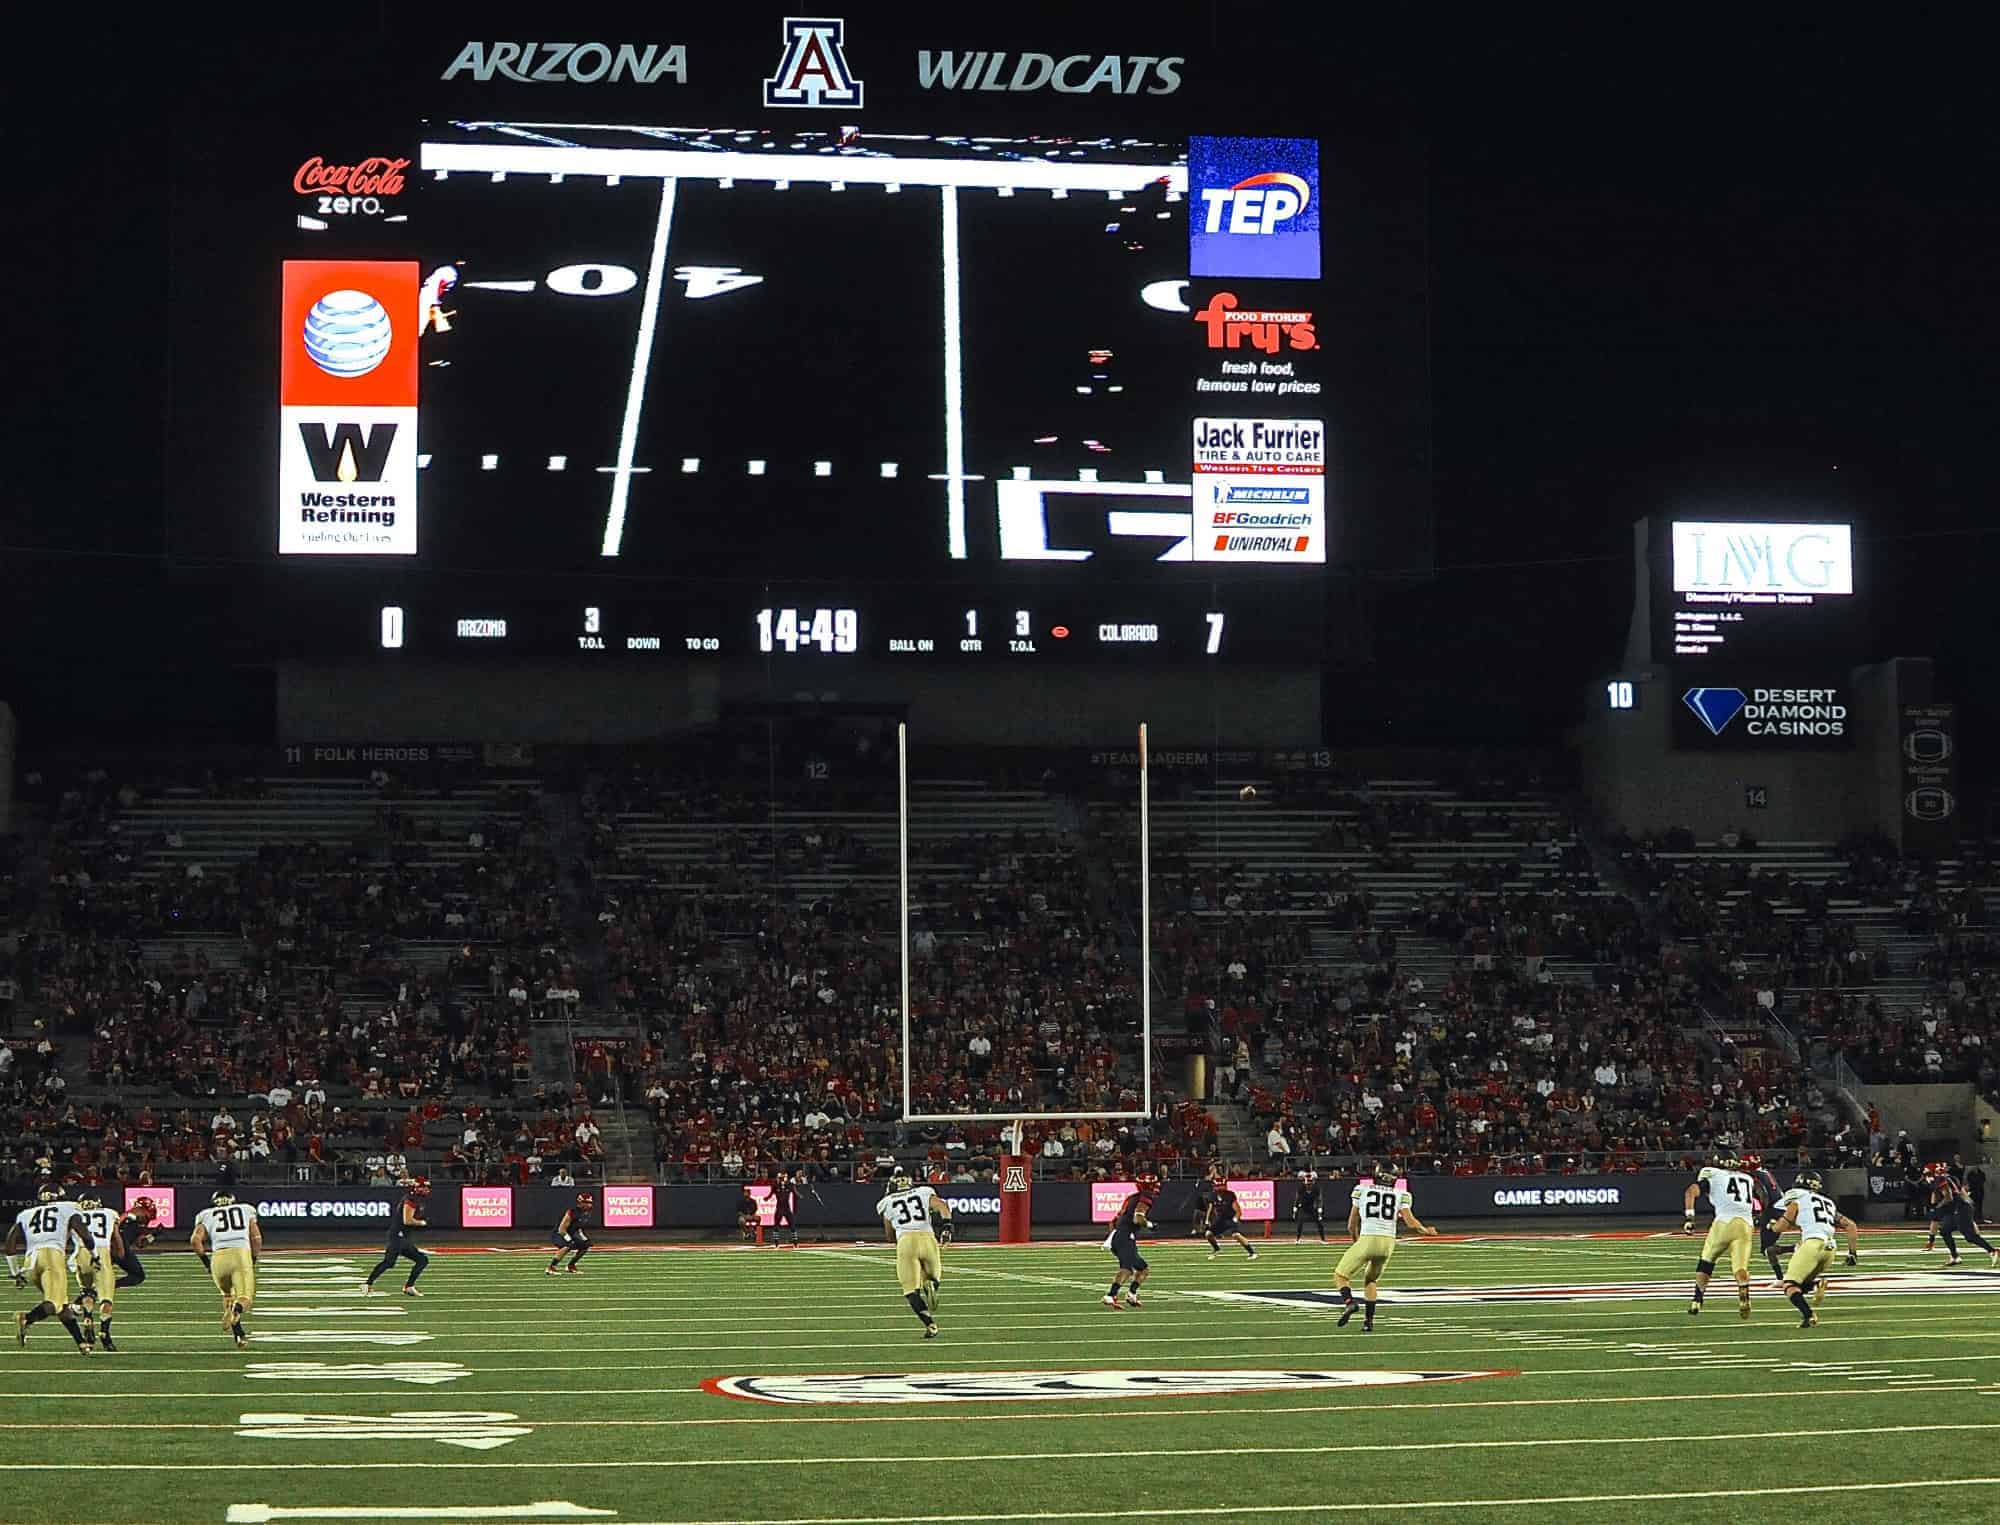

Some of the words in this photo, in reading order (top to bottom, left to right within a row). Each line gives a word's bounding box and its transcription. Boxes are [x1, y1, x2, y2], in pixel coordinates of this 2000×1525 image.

[441, 41, 688, 84] ARIZONA
[763, 17, 864, 108] A
[918, 50, 1185, 95] WILDCATS
[1201, 188, 1299, 235] TEP
[1224, 312, 1257, 322] FOOD
[1260, 312, 1306, 322] STORES
[1221, 361, 1256, 374] fresh
[1260, 362, 1295, 376] food,
[1197, 379, 1248, 393] famous
[1251, 380, 1276, 393] low
[1278, 381, 1321, 395] prices
[1197, 422, 1245, 450] Jack
[1253, 423, 1320, 450] Furrier
[298, 422, 398, 483] W
[1199, 450, 1229, 461] TIRE
[1232, 451, 1240, 461] &
[1246, 451, 1282, 462] AUTO
[1286, 452, 1321, 462] CARE
[1200, 464, 1249, 473] Western
[1252, 465, 1274, 473] Tire
[1277, 465, 1323, 473] Centers
[301, 492, 396, 508] Western
[1231, 489, 1306, 500] MICHELIN
[301, 508, 396, 526] Refining
[1213, 512, 1312, 525] BFGoodrich
[1228, 536, 1293, 551] UNIROYAL
[1687, 532, 1836, 589] IMG
[381, 606, 404, 649] 0
[456, 619, 507, 638] ARIZONA
[584, 607, 600, 633] 3
[965, 610, 977, 636] 1
[1016, 610, 1030, 636] 3
[756, 607, 859, 653] 14:49
[1099, 624, 1158, 642] COLORADO
[1206, 613, 1225, 654] 7
[627, 637, 660, 649] DOWN
[685, 638, 701, 650] TO
[703, 638, 720, 650] GO
[889, 640, 915, 652] BALL
[917, 640, 933, 652] ON
[960, 640, 982, 652] QTR
[1608, 682, 1633, 709] 10
[1754, 688, 1837, 704] DESERT
[1744, 704, 1847, 720] DIAMOND
[1747, 721, 1844, 737] CASINOS
[284, 746, 302, 764] 11
[314, 747, 356, 762] FOLK
[360, 747, 431, 762] HEROES
[1312, 752, 1331, 769] 13
[807, 760, 829, 780] 12
[1746, 788, 1767, 806] 14
[297, 1168, 309, 1181] 11
[1494, 1190, 1549, 1205] GAME
[1552, 1189, 1619, 1204] SPONSOR
[1726, 1177, 1752, 1204] 47
[257, 1201, 307, 1217] GAME
[310, 1201, 391, 1217] SPONSOR
[466, 1197, 508, 1207] WELLS
[608, 1196, 649, 1206] WELLS
[945, 1198, 1000, 1213] PONSO
[1239, 1200, 1270, 1209] ARGO
[1366, 1191, 1396, 1220] 28
[467, 1207, 508, 1217] FARGO
[609, 1206, 649, 1217] FARGO
[892, 1195, 926, 1225] 33
[1811, 1197, 1836, 1227] 25
[29, 1206, 59, 1234] 46
[212, 1206, 245, 1232] 30
